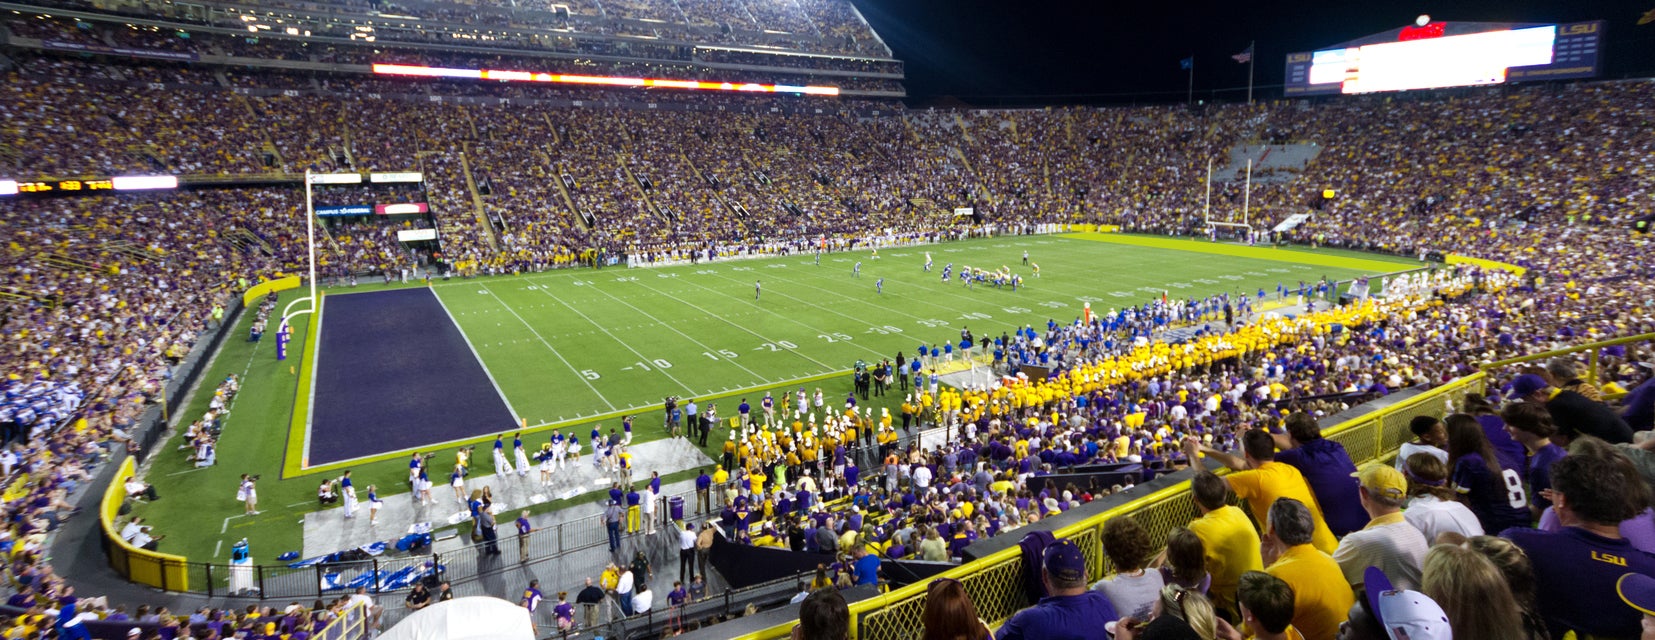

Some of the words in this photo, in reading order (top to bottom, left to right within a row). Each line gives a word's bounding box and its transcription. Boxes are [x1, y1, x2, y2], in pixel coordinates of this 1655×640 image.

[1560, 24, 1597, 35] LSU
[817, 332, 853, 343] 25
[761, 340, 799, 352] 20
[702, 349, 739, 361] 15
[635, 358, 673, 372] 10
[581, 369, 601, 381] 5
[1591, 550, 1628, 567] LSU
